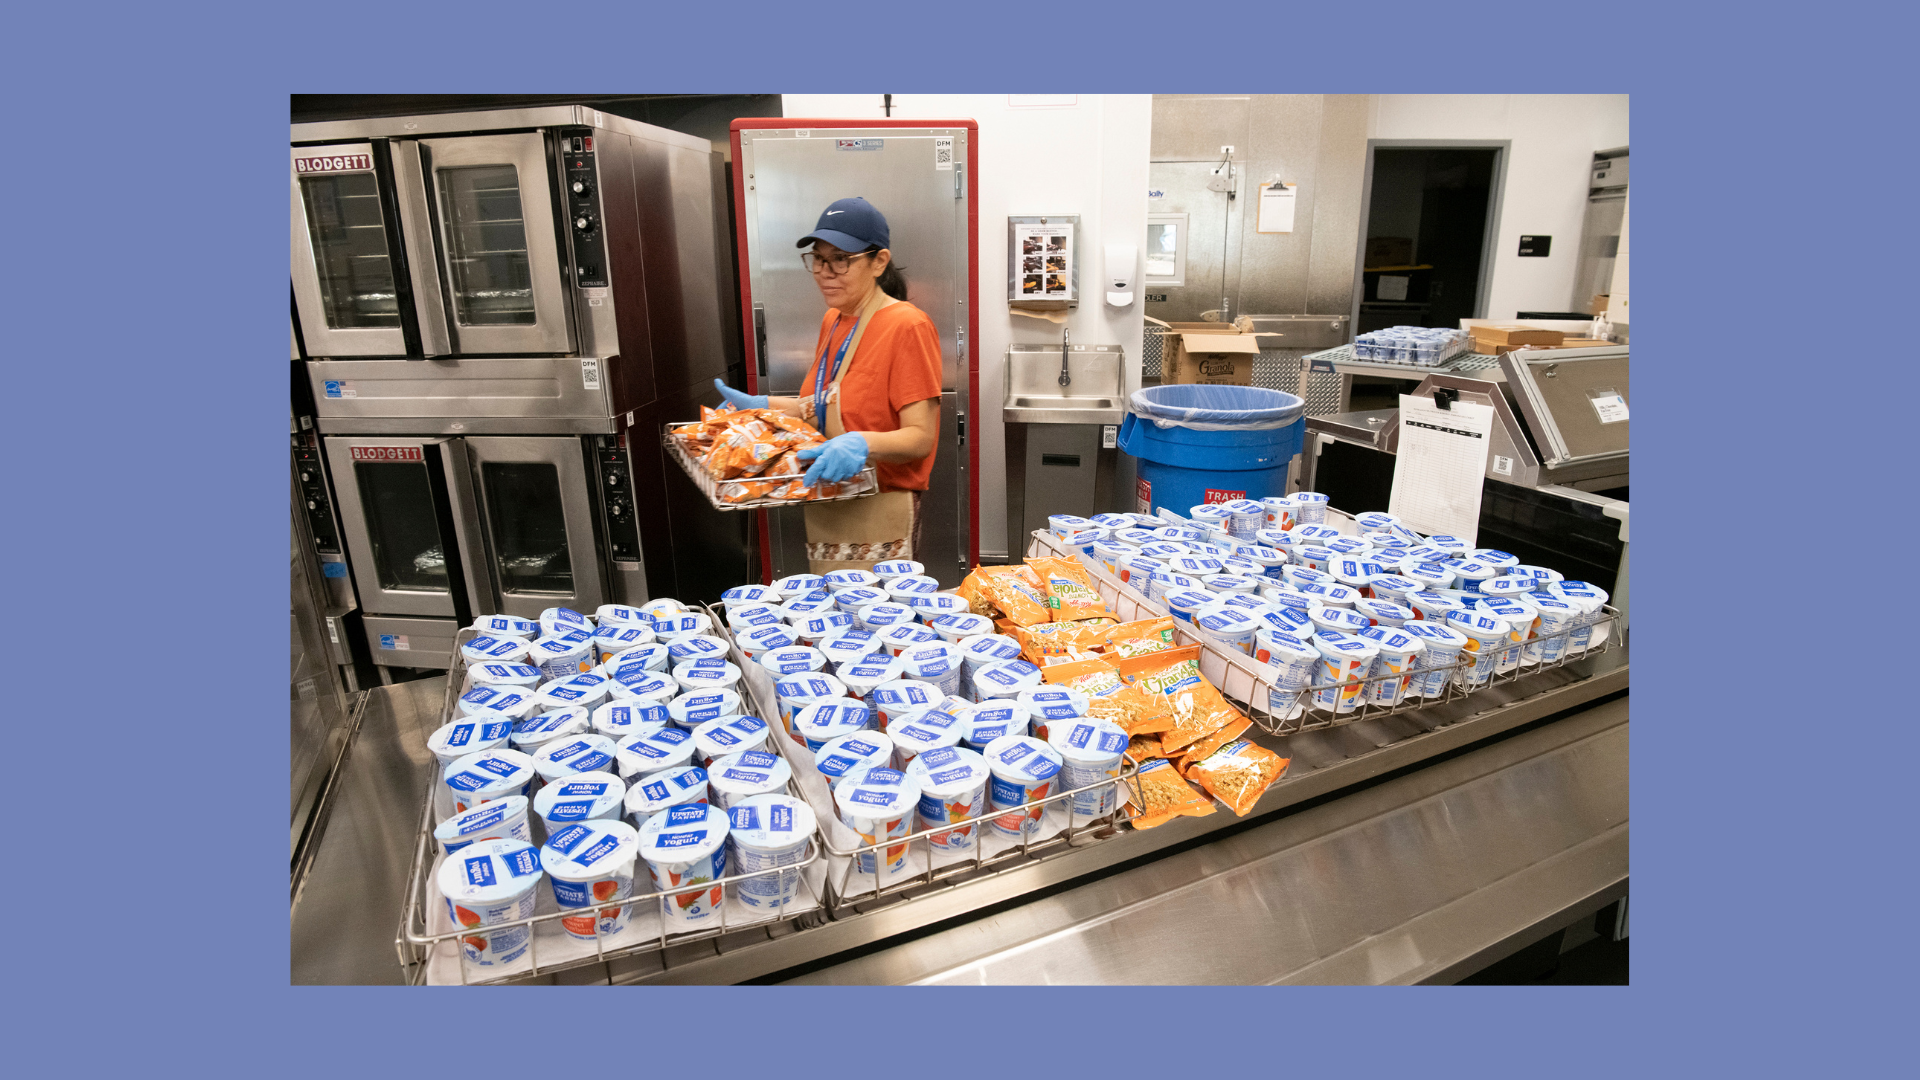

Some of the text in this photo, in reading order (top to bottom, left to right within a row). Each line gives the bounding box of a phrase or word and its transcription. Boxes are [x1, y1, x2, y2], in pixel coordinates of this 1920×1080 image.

[297, 155, 366, 171] BLODGETT
[1199, 360, 1234, 374] Granola
[353, 448, 417, 459] BLODGETT
[1208, 491, 1244, 500] TRASH
[980, 709, 1008, 718] yogurt
[712, 733, 732, 745] yogurt
[1072, 726, 1086, 744] yogurt
[636, 746, 660, 758] yogurt
[850, 741, 874, 752] yogurt
[1002, 745, 1026, 760] yogurt
[744, 755, 774, 765] UPSTATE
[924, 752, 954, 764] UPSTATE
[486, 758, 512, 772] yogurt
[730, 774, 760, 782] yogurt
[938, 771, 968, 782] yogurt
[568, 784, 600, 792] yogurt
[994, 784, 1020, 798] UPSTATE
[858, 794, 890, 803] yogurt
[672, 810, 705, 818] UPSTATE
[736, 808, 745, 828] UPSTATE
[780, 808, 790, 828] yogurt
[553, 827, 585, 848] UPSTATE
[560, 832, 584, 848] FARMS
[664, 836, 699, 846] yogurt
[584, 841, 616, 862] yogurt
[520, 850, 534, 874] UPSTATE
[470, 861, 484, 884] yogurt
